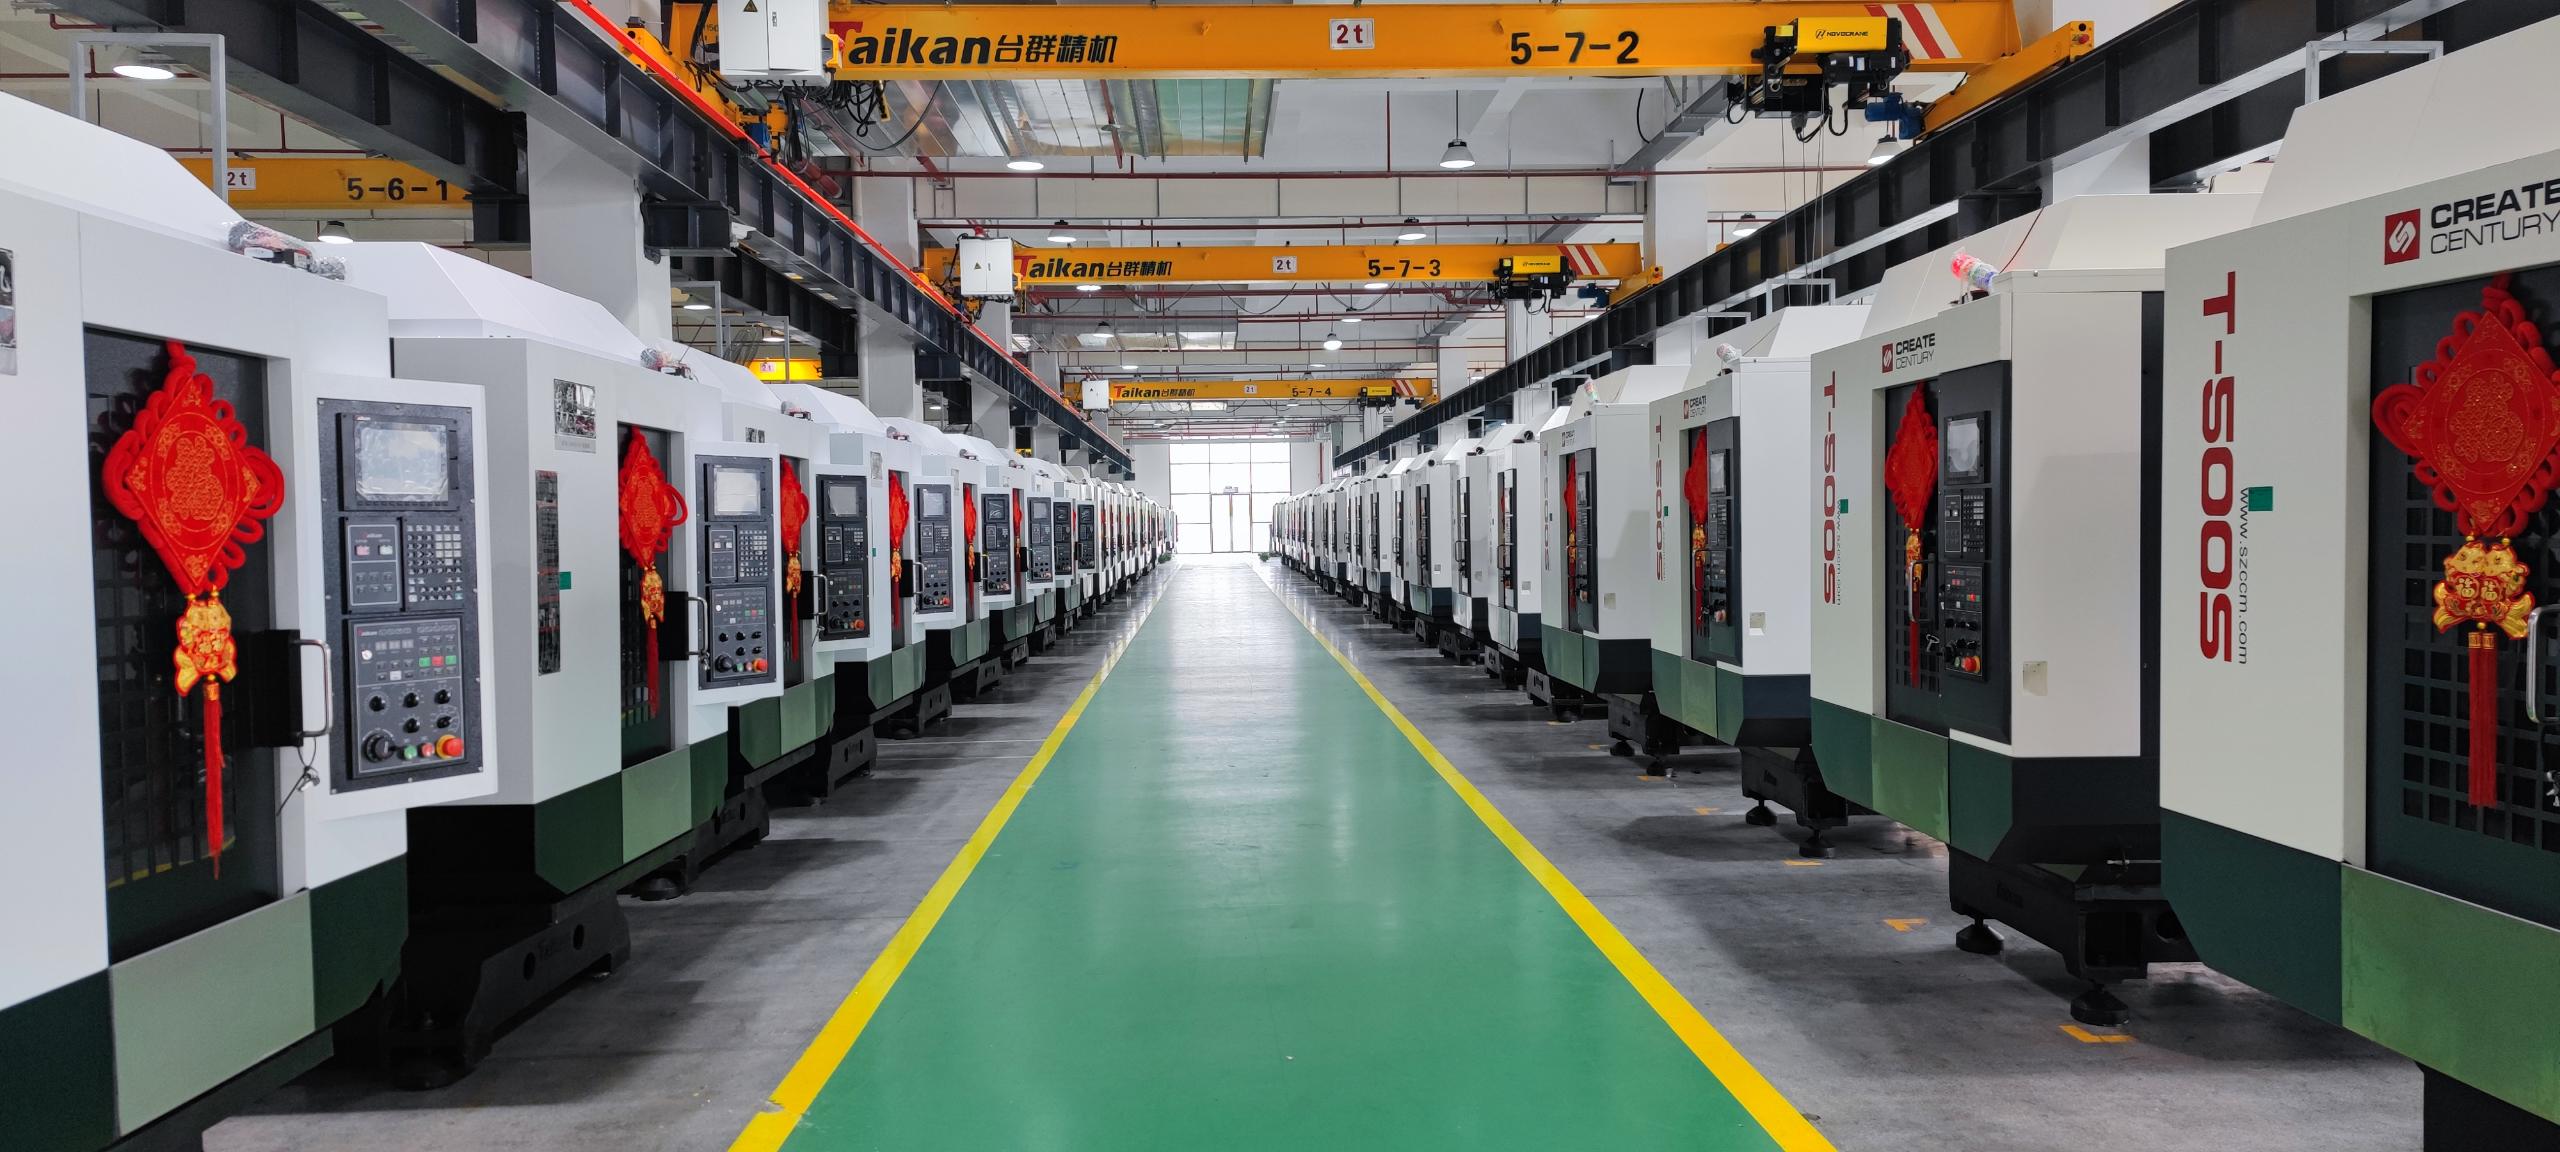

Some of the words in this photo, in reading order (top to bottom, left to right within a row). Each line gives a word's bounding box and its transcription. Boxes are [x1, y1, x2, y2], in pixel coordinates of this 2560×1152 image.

[1337, 24, 1364, 44] 2t
[994, 34, 1119, 63] 台群精机
[1510, 30, 1640, 65] 5-7-2
[347, 177, 448, 201] 5-6-1
[2431, 178, 2560, 229] CREATE
[2431, 209, 2560, 254] CENTURY
[1014, 255, 1105, 278] Taikan
[1106, 261, 1173, 277] 台群精机
[1276, 259, 1291, 270] 2t
[1368, 259, 1441, 278] 5-7-3
[1895, 332, 1936, 356] CREATE
[1895, 348, 1935, 370] CENTURY
[1114, 385, 1161, 398] Taikan
[1292, 387, 1332, 397] 5-7-4
[2200, 270, 2236, 663] T-500S
[1823, 370, 1836, 605] T-500S
[2238, 486, 2250, 666] www.szccm.com
